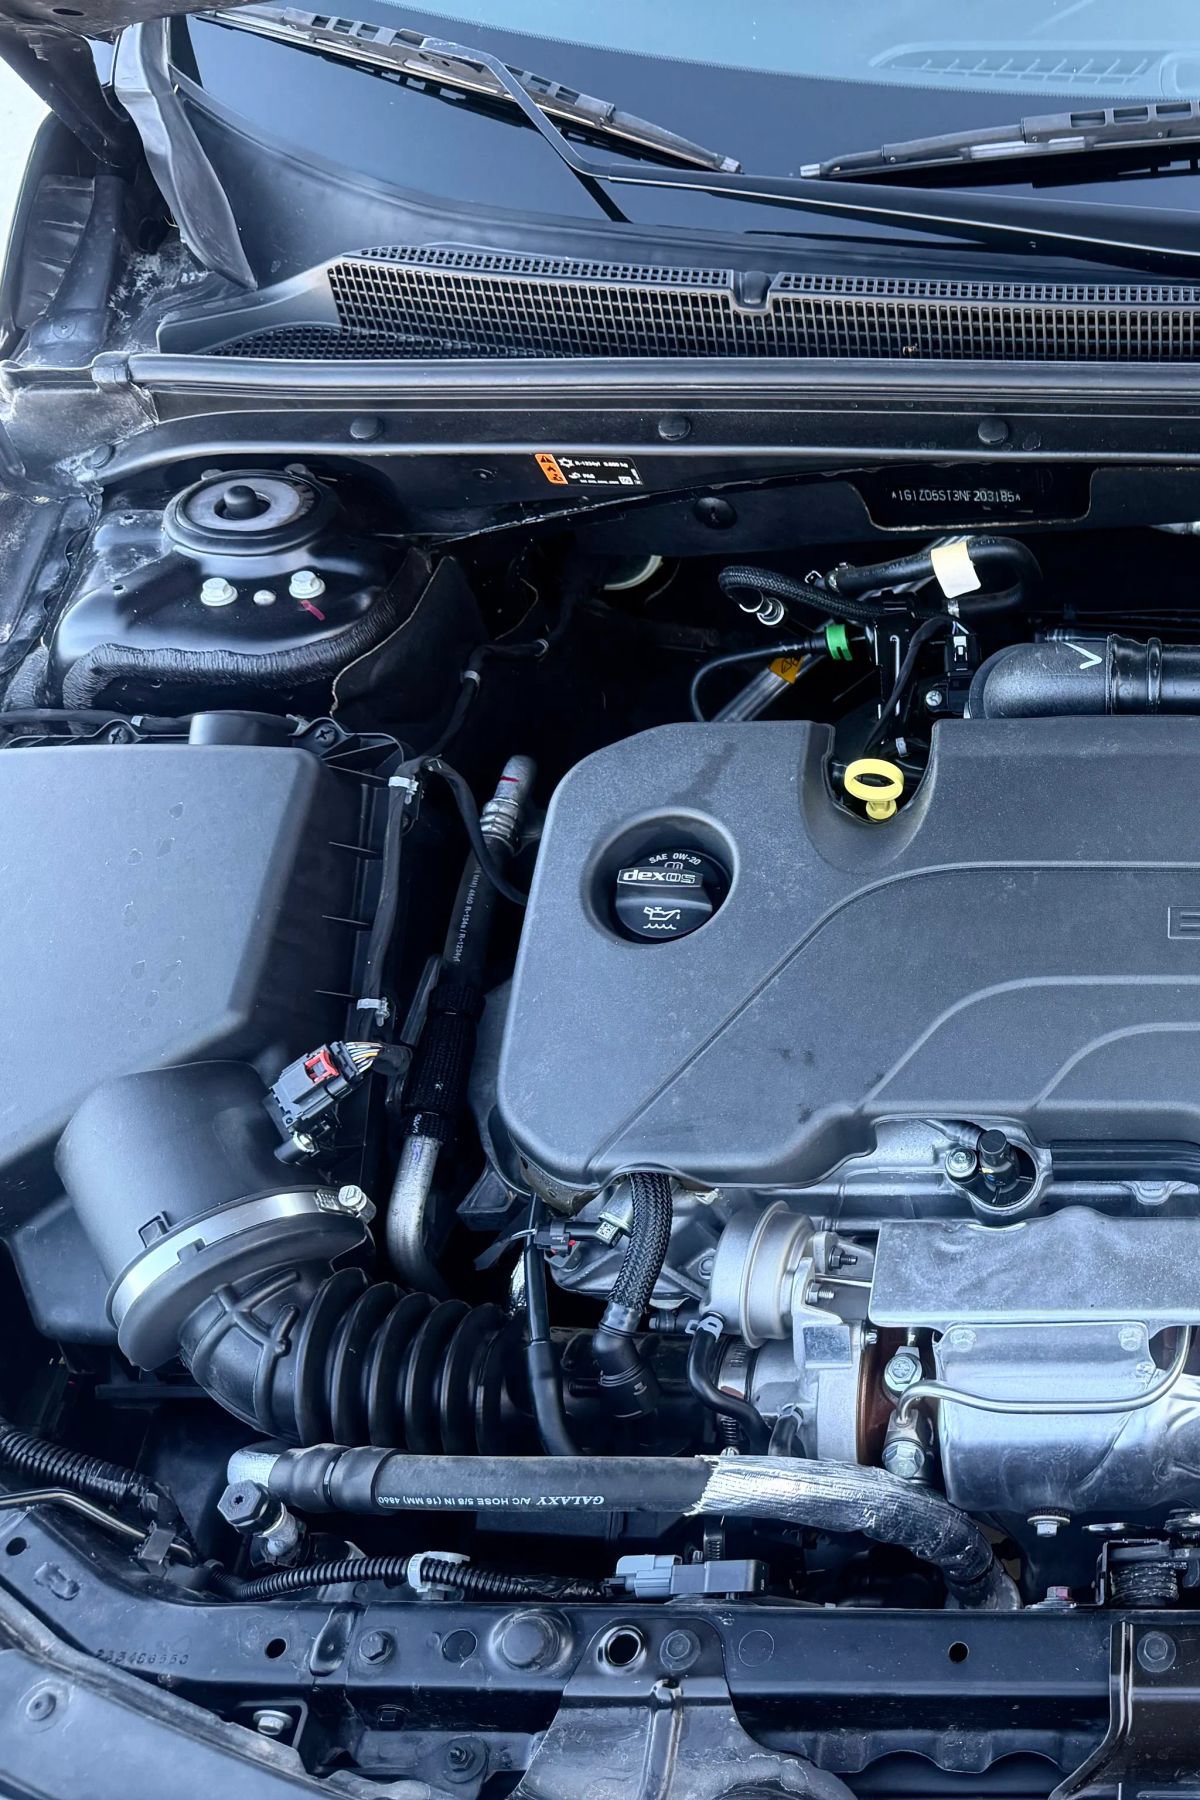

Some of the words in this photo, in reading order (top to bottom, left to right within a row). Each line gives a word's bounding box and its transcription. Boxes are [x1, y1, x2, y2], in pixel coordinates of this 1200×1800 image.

[648, 853, 668, 864] SAE
[672, 852, 702, 866] 0W-20
[622, 869, 696, 884] dexos
[443, 1496, 456, 1505] IN
[477, 1496, 509, 1506] HOSE
[535, 1495, 605, 1506] GALAXY
